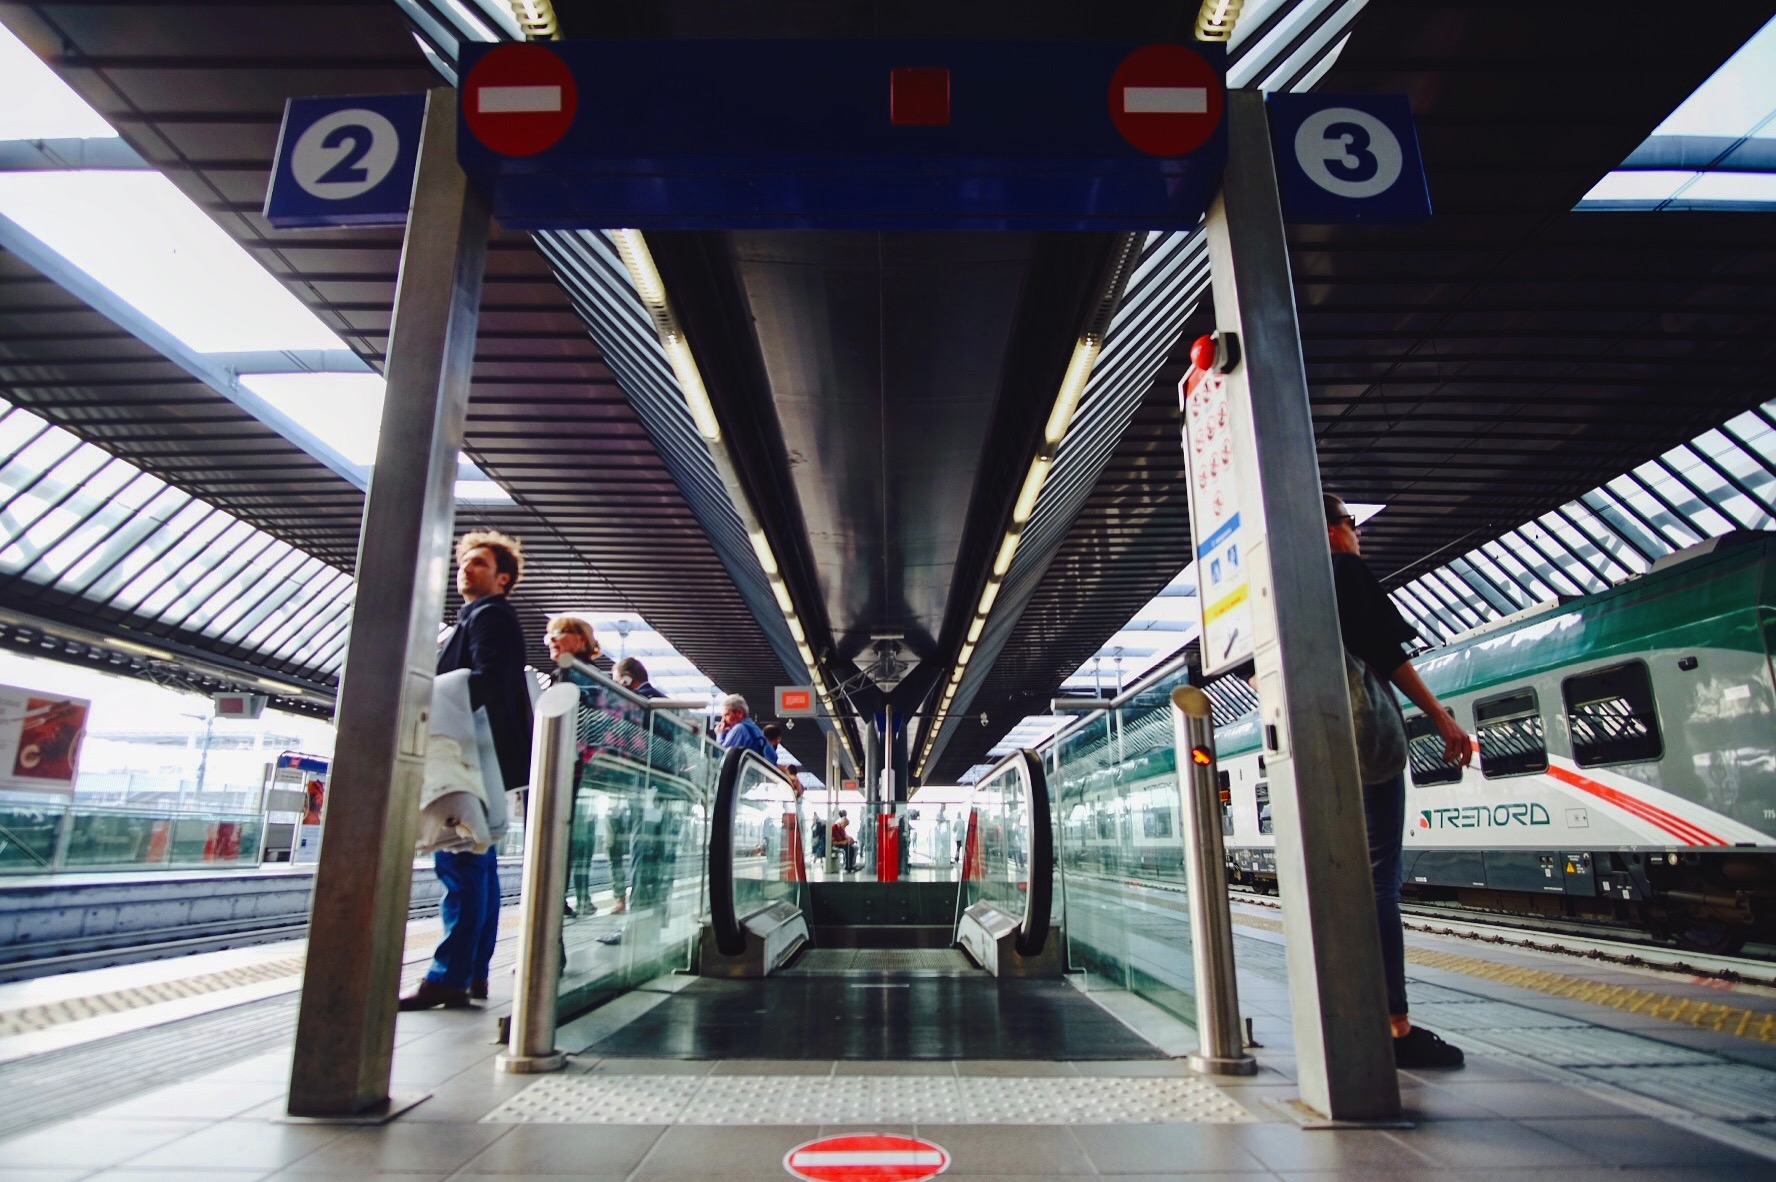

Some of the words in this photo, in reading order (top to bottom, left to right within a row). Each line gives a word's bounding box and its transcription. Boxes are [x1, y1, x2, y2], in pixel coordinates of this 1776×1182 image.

[314, 124, 374, 184] 2
[1322, 121, 1379, 183] 3
[1433, 802, 1551, 829] TRENORD
